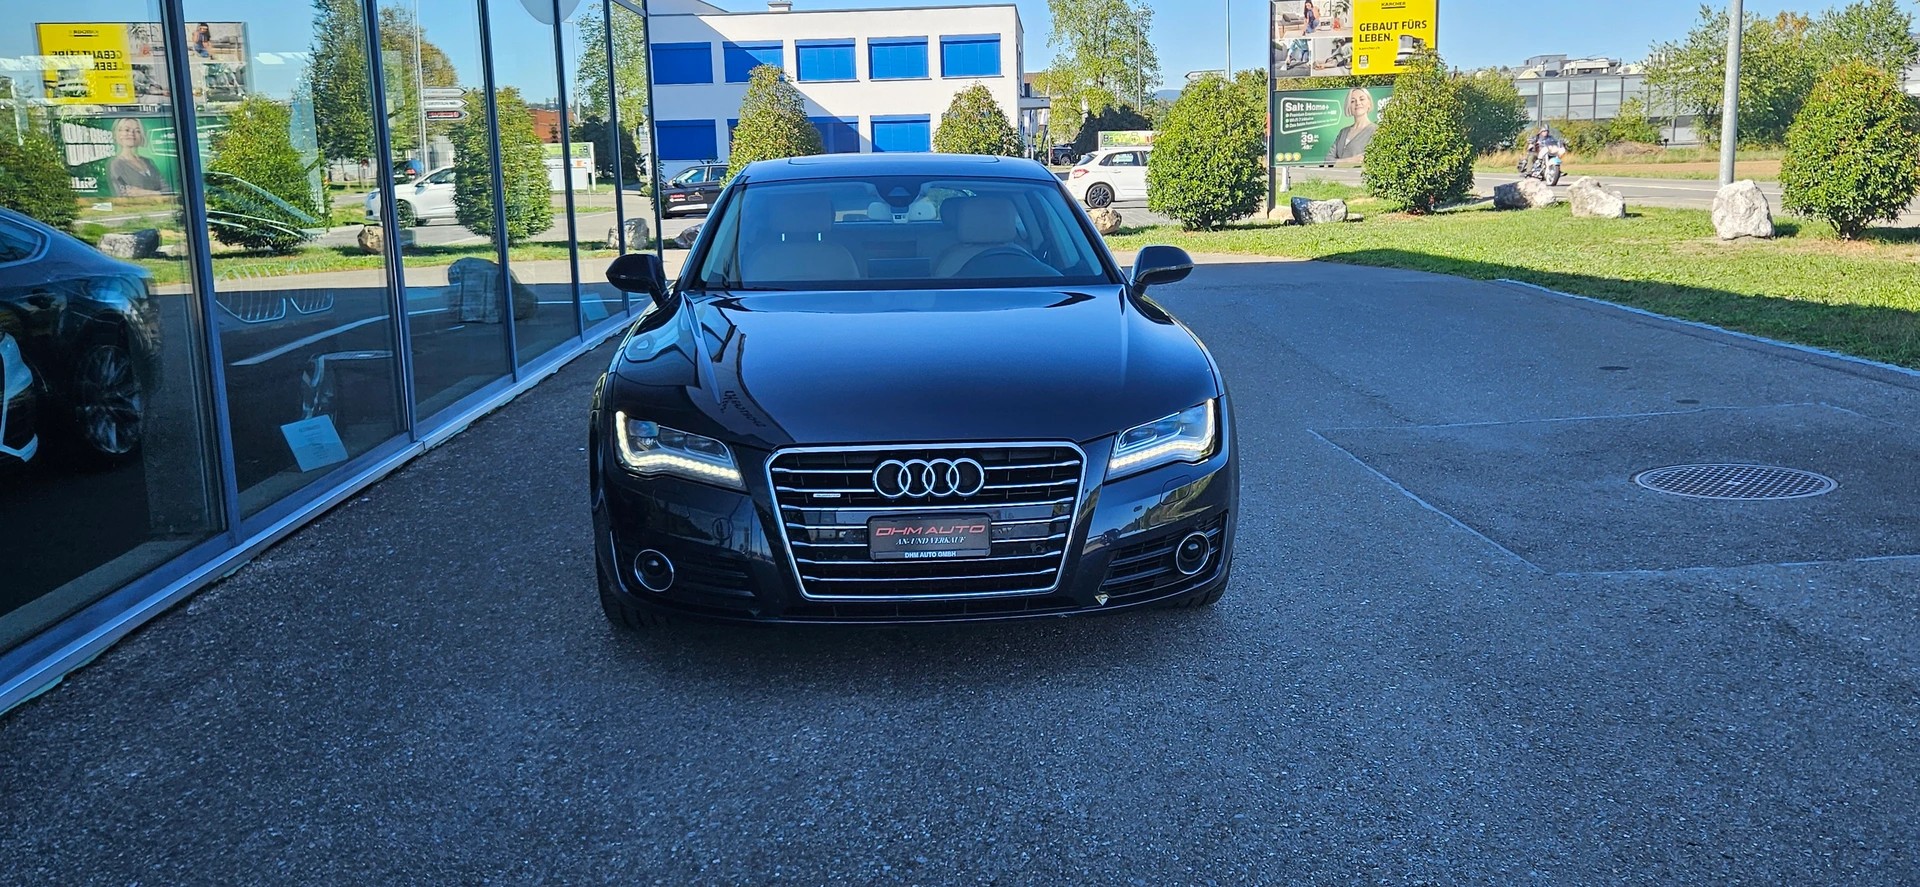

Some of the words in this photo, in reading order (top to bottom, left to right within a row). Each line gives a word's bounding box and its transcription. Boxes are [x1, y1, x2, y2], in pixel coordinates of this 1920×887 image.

[1359, 22, 1399, 31] GEBAUT
[1401, 19, 1427, 30] FÜRS
[1359, 33, 1394, 42] LEBEN.
[1285, 102, 1304, 112] Salt
[1306, 102, 1330, 111] Home+
[875, 527, 923, 536] DHM
[925, 525, 986, 535] AUTO
